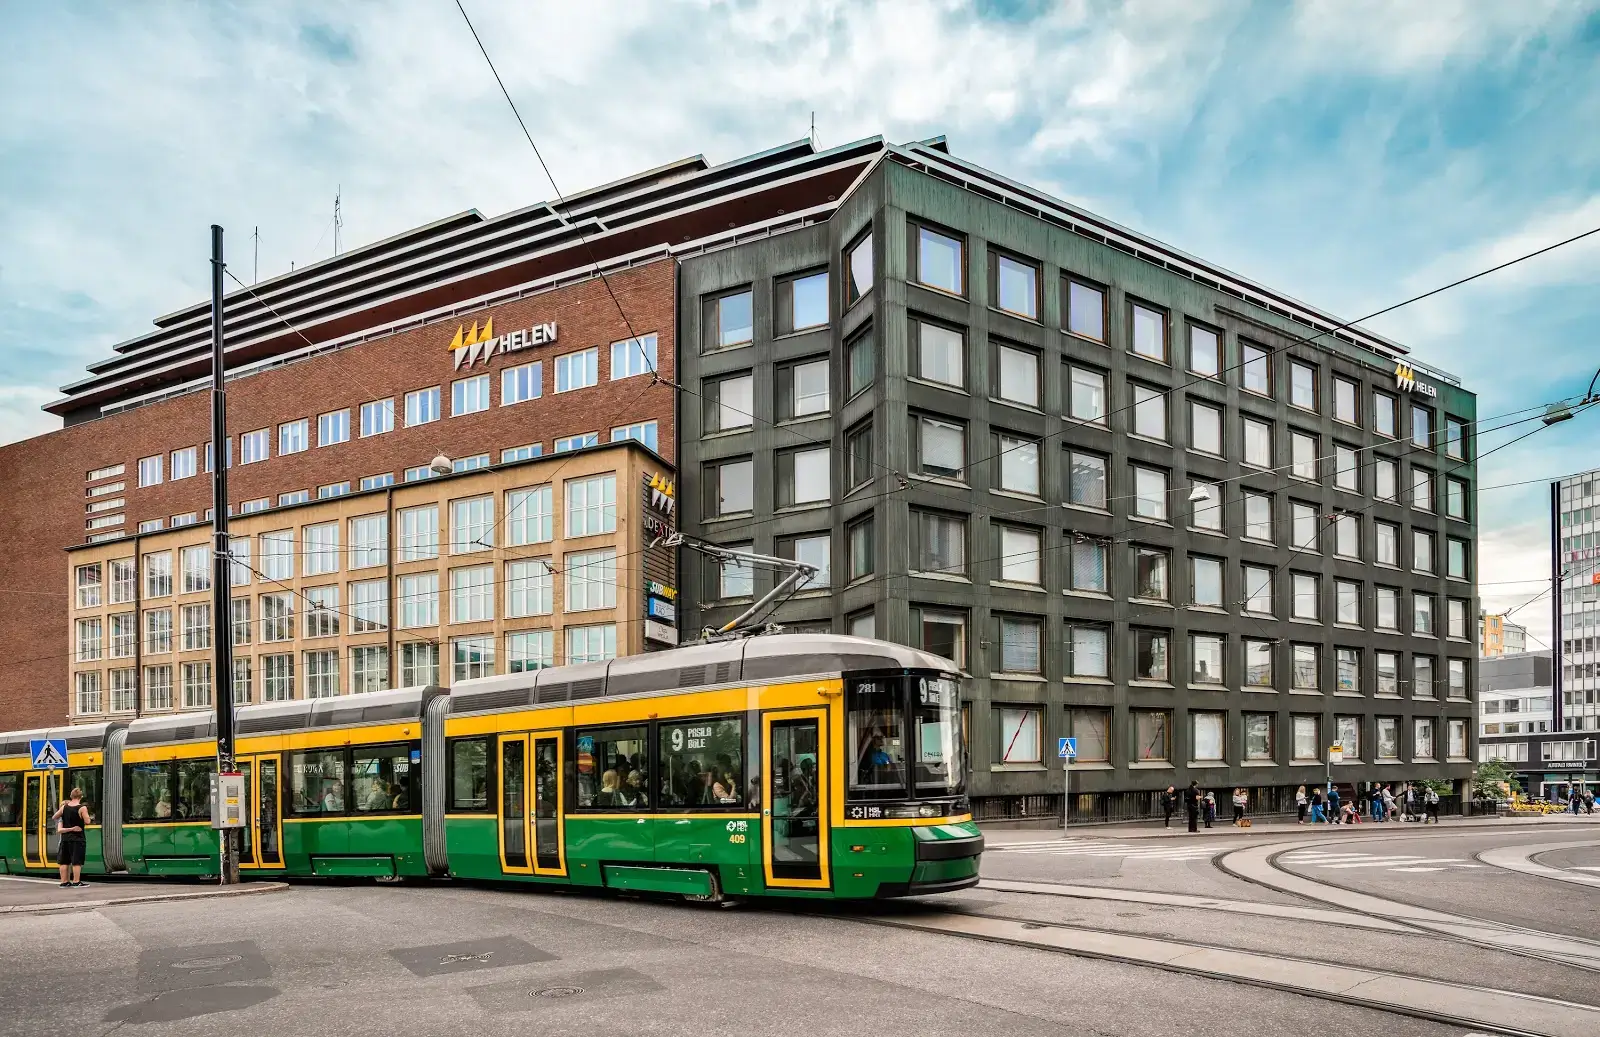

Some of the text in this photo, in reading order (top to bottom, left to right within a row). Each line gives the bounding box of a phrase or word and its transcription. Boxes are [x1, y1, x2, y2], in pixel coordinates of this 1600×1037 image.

[500, 321, 557, 353] HELEN
[1417, 381, 1436, 397] HELEN
[648, 516, 678, 538] DEXTR
[650, 581, 677, 600] SUBWAY
[919, 677, 928, 703] 9
[672, 727, 712, 752] 9 PASILA
[729, 834, 746, 844] 409
